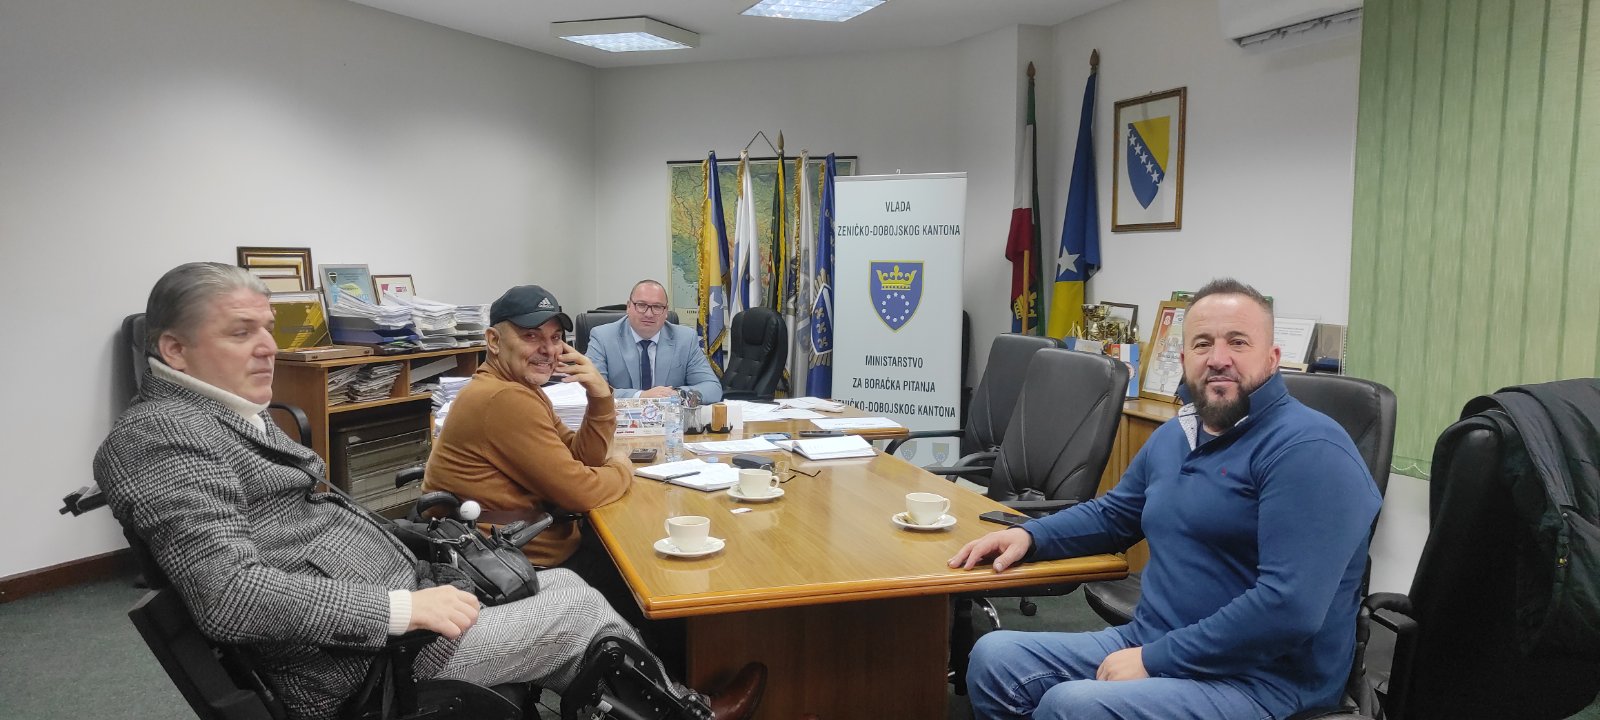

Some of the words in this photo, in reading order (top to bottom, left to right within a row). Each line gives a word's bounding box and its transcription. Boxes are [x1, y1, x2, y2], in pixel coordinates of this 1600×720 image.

[885, 201, 911, 212] VLADA
[837, 223, 920, 236] ZENIČKO-DOBOJSKOG
[922, 224, 961, 236] KANTONA
[865, 355, 923, 368] MINISTARSTVO
[852, 377, 862, 388] ZA
[864, 376, 901, 390] BORAČKA
[903, 380, 936, 393] PITANJA
[917, 405, 956, 418] KANTONA
